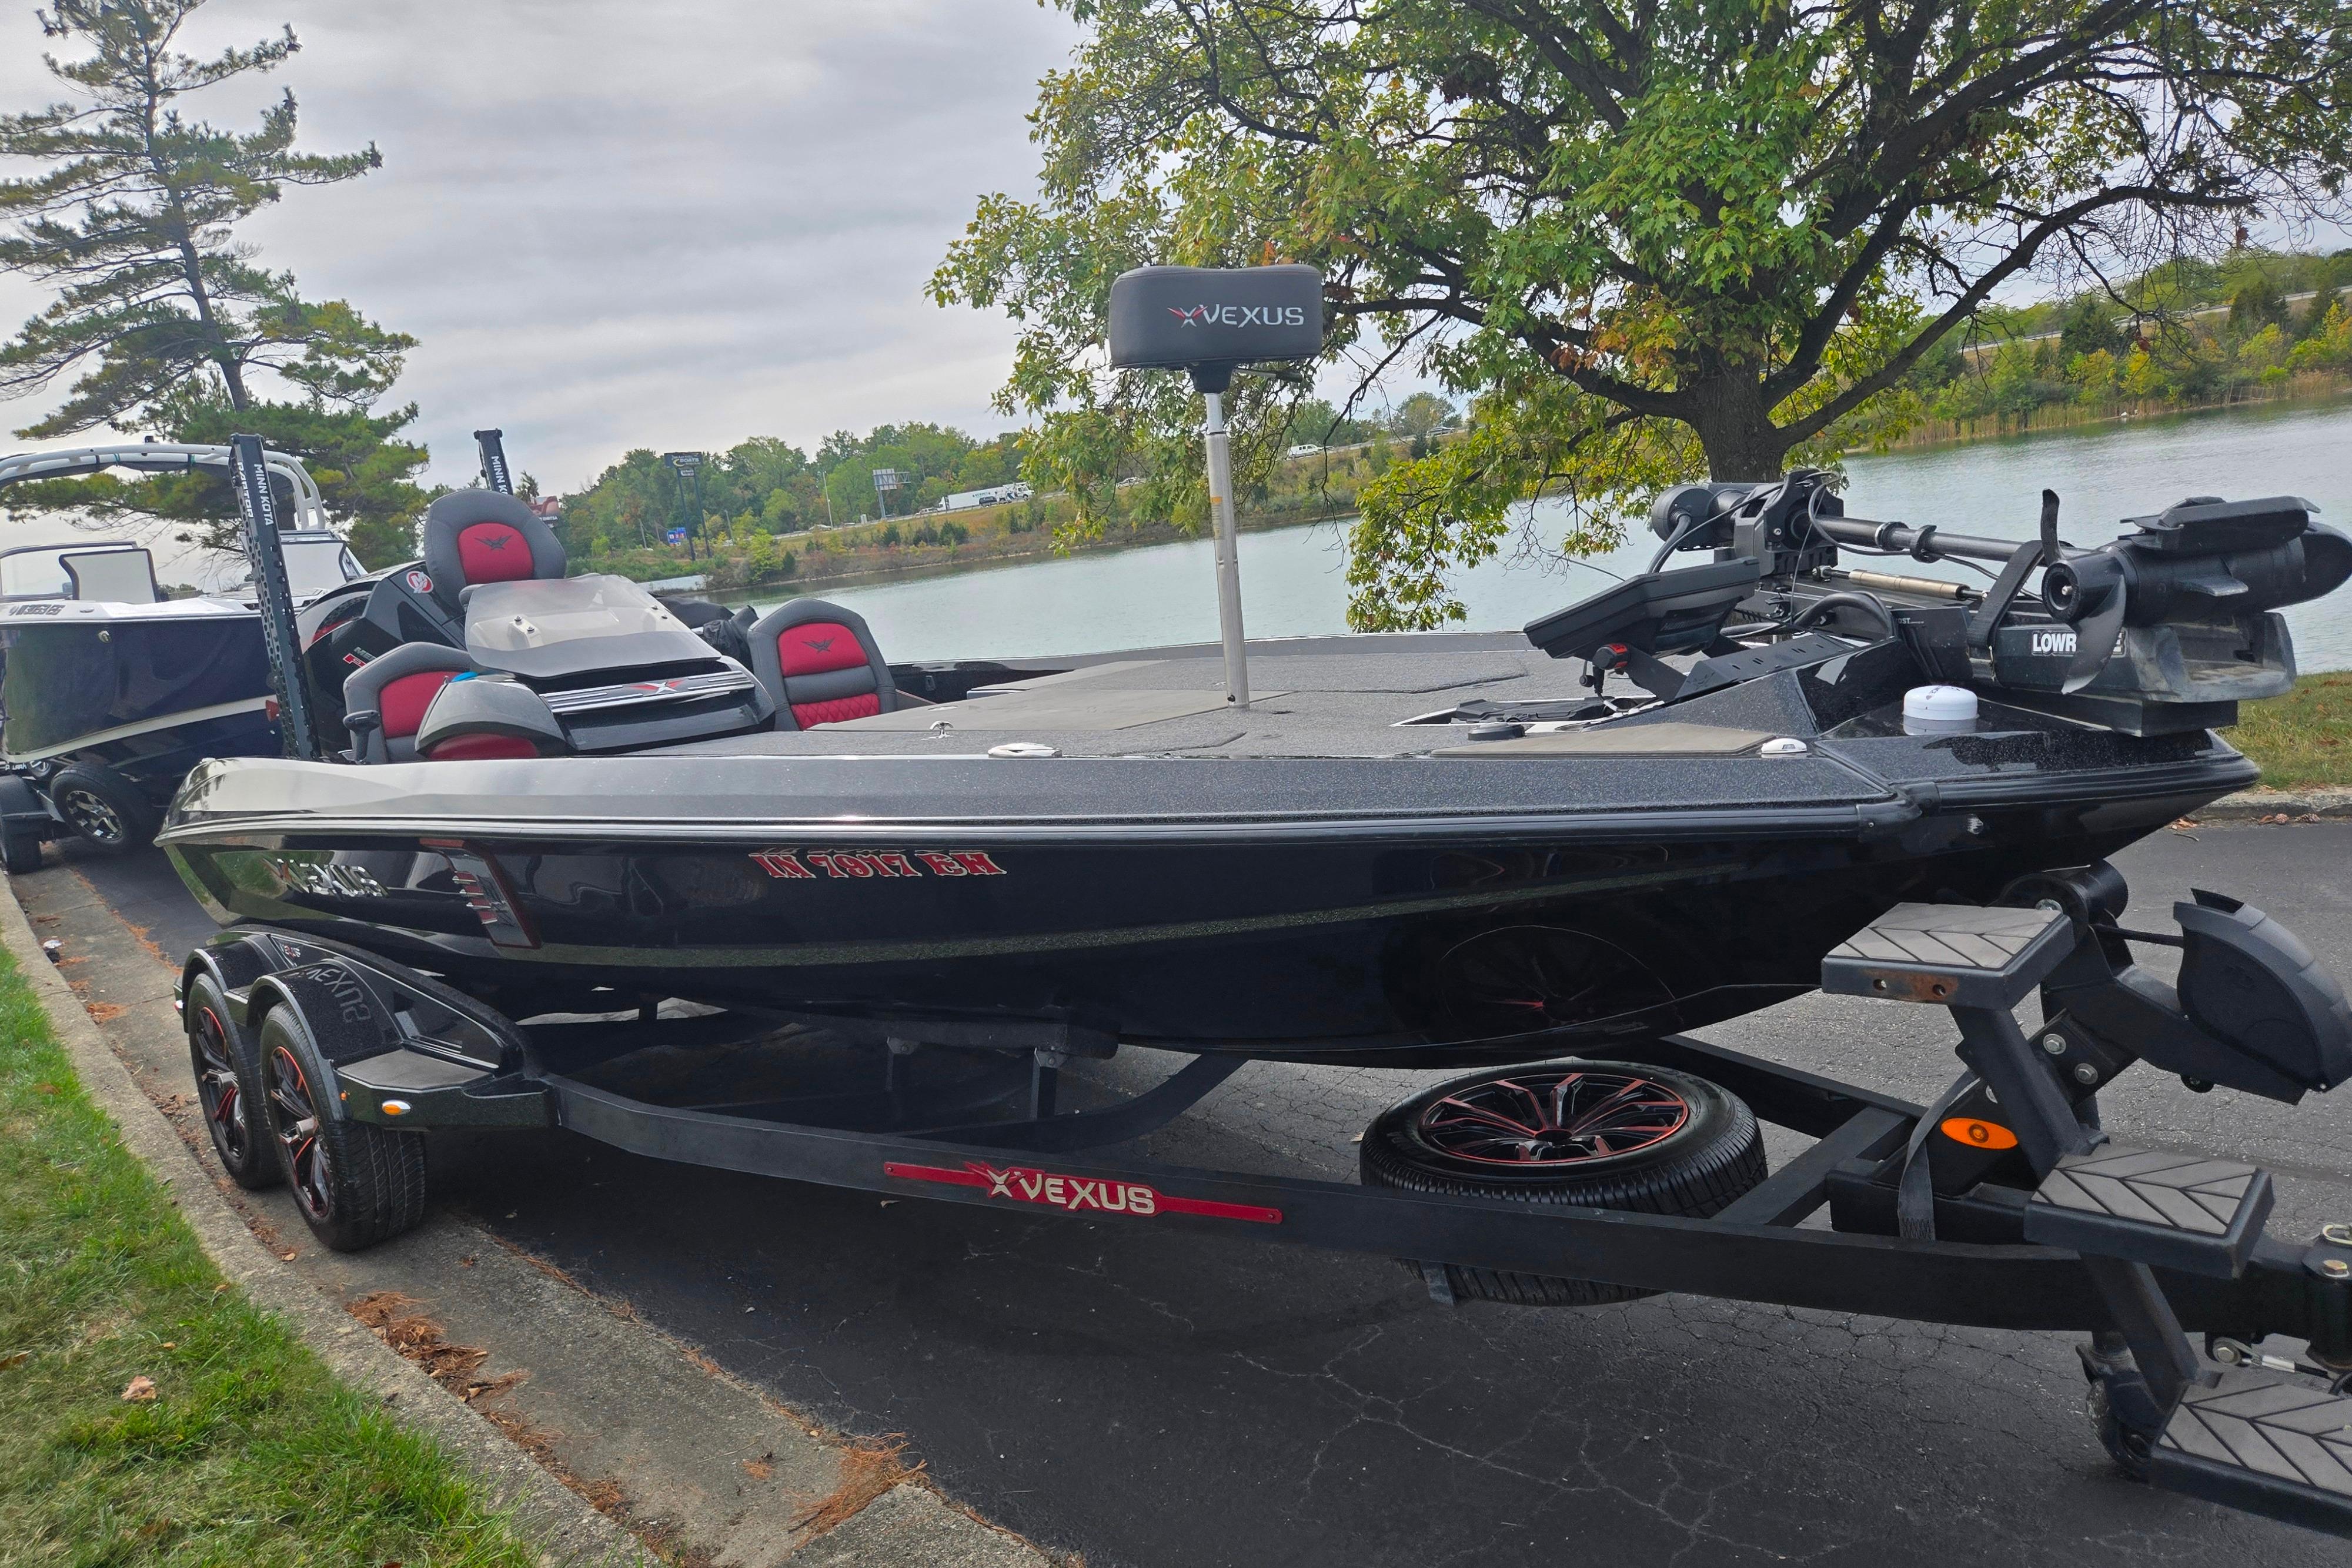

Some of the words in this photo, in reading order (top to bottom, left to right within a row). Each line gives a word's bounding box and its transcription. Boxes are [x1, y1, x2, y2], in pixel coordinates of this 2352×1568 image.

[1200, 304, 1304, 328] VEXUS
[253, 464, 268, 494] MINN
[491, 456, 506, 483] MINN
[237, 462, 254, 518] RAPTOR
[260, 496, 275, 526] KOTA
[749, 852, 817, 878] IN
[1014, 1171, 1155, 1215] VEXUS
